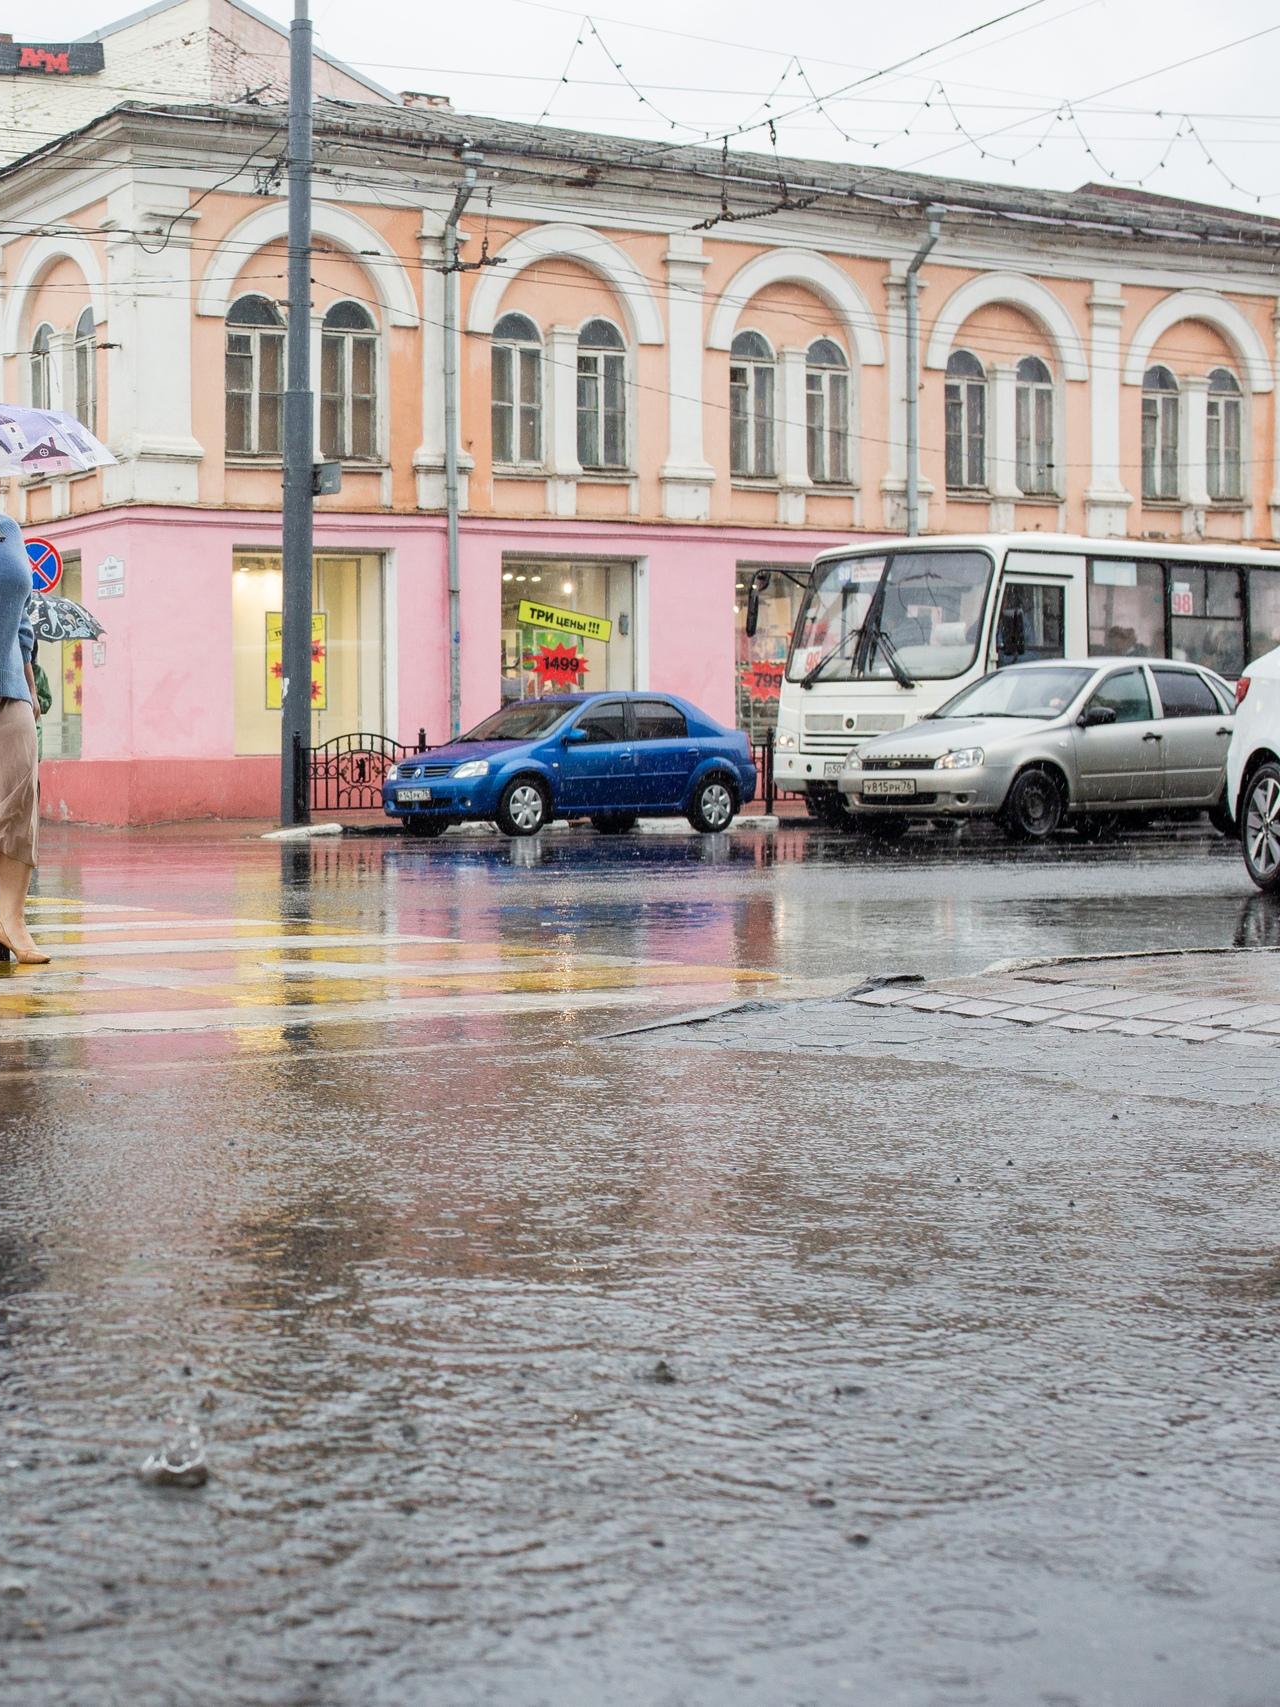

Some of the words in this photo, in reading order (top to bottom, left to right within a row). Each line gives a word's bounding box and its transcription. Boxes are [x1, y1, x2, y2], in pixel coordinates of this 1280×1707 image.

[1173, 593, 1191, 613] 98
[529, 607, 554, 623] ТРИ
[556, 615, 587, 631] ЦЕНЫ
[543, 656, 580, 672] 1499
[753, 673, 782, 688] 799
